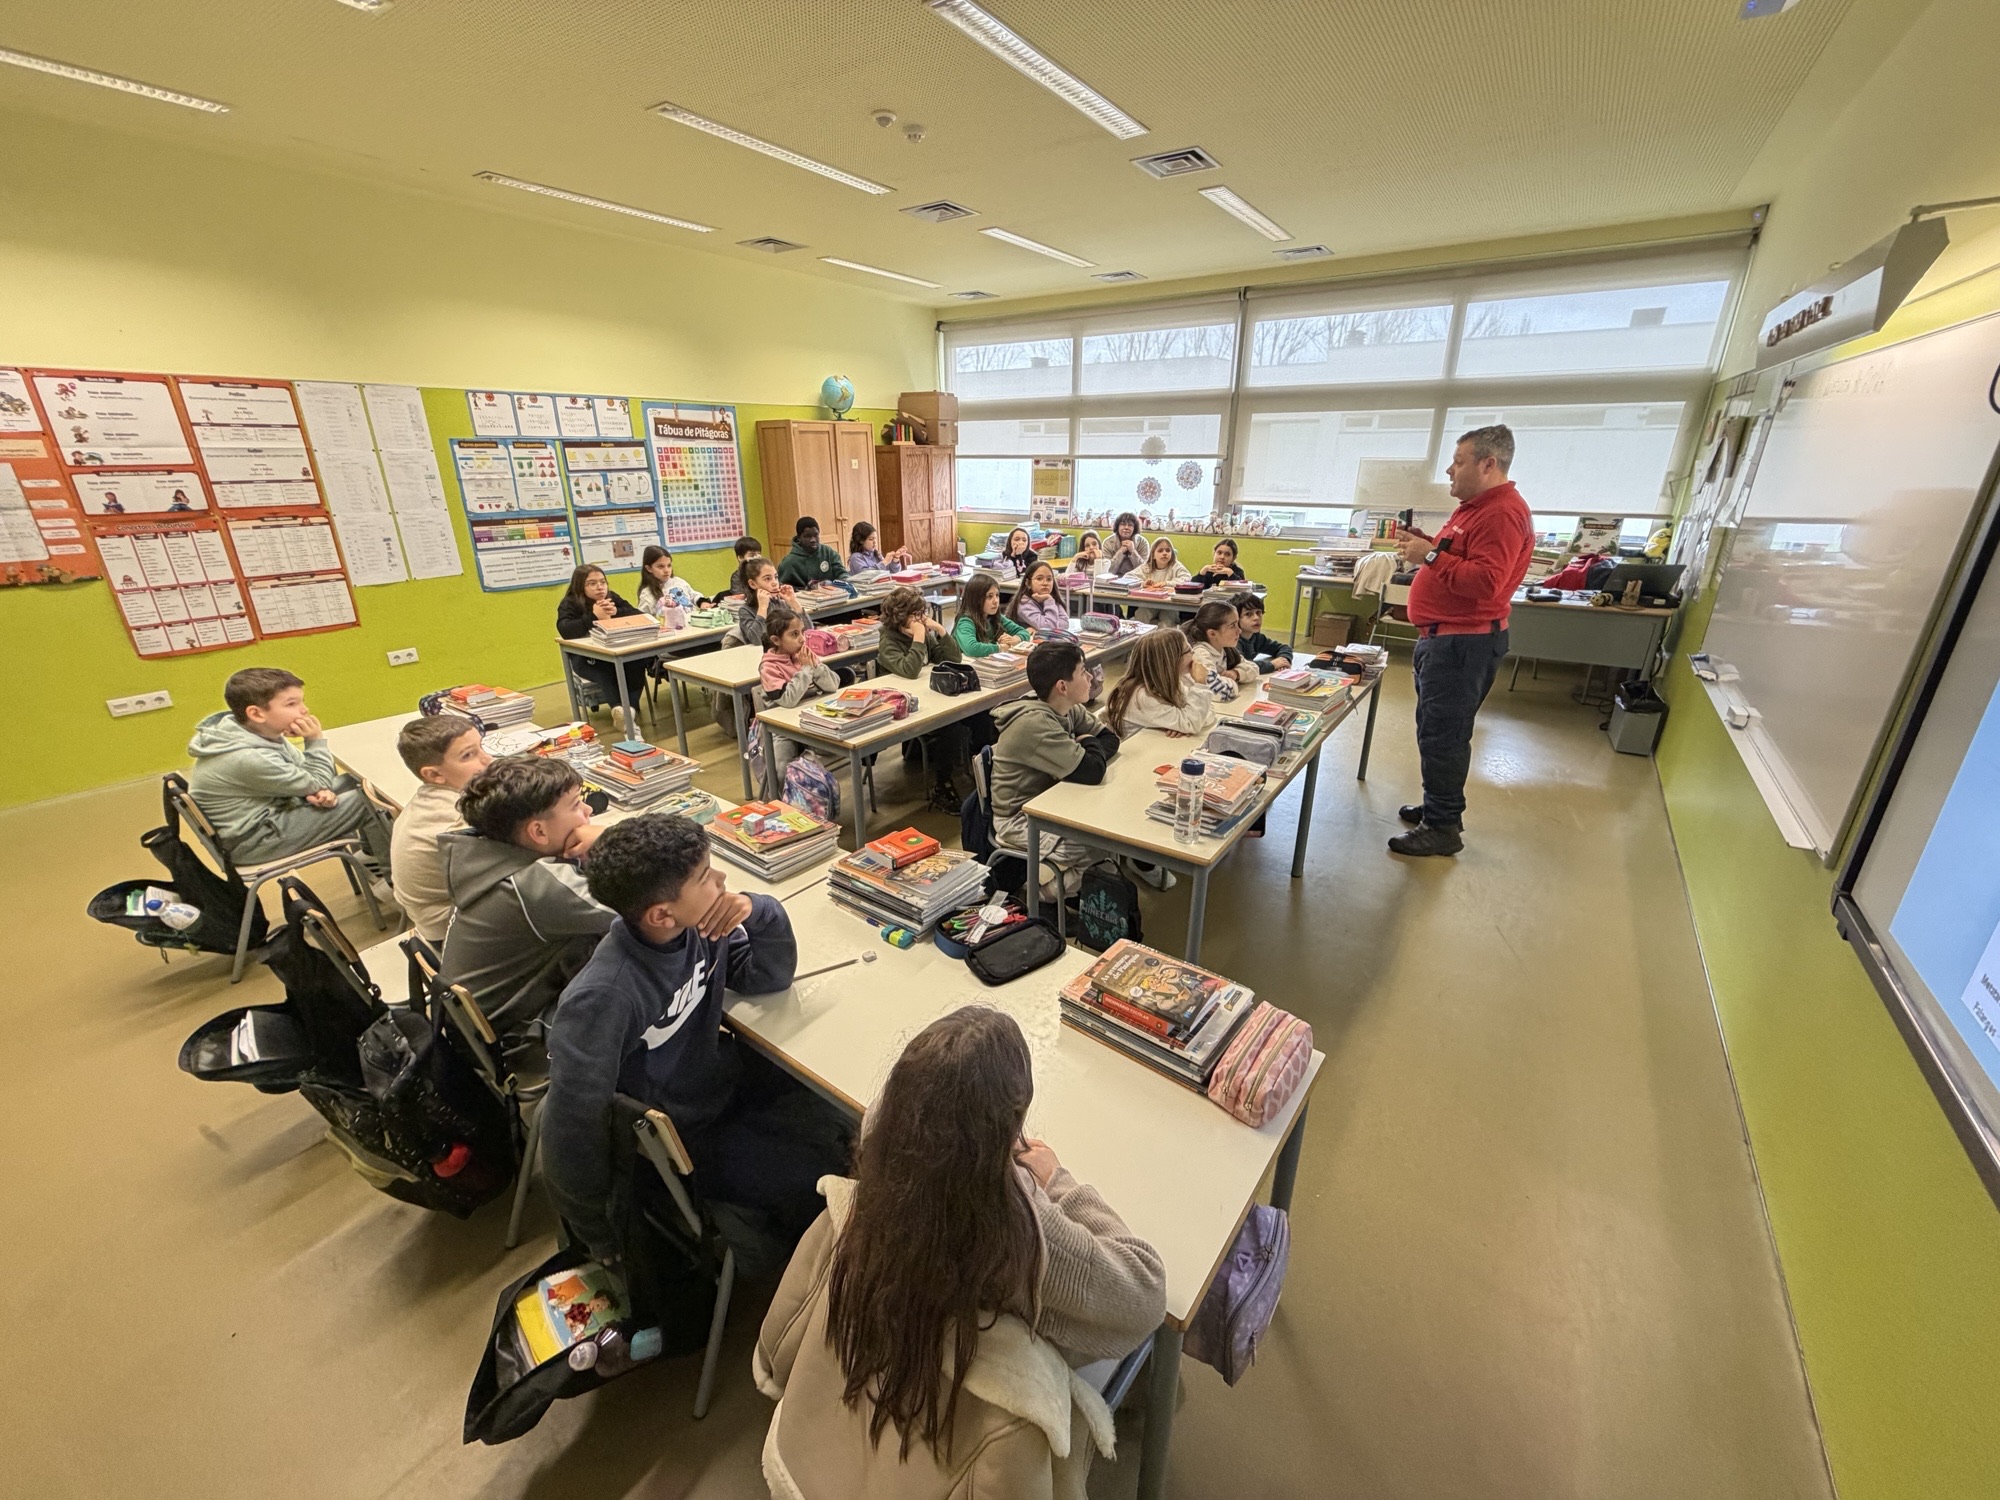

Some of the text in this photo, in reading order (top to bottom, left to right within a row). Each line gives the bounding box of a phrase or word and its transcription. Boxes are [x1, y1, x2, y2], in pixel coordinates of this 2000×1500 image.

[657, 424, 729, 440] Tábua de Pitágoras
